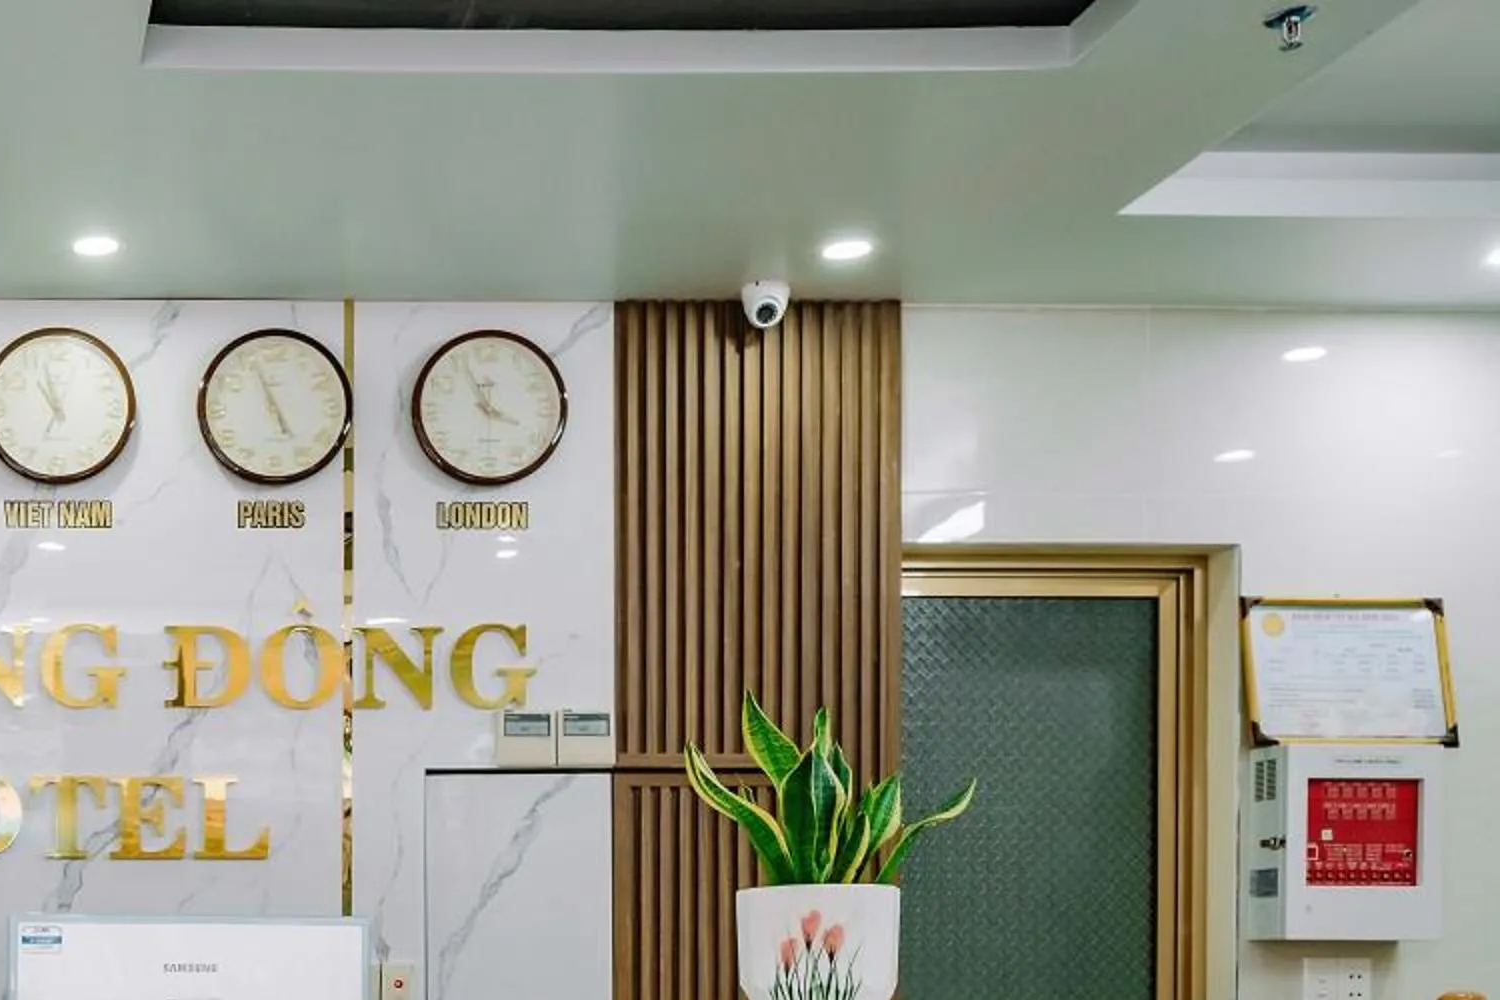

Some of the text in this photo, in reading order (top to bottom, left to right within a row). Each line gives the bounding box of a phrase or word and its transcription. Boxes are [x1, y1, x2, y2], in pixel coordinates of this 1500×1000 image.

[4, 500, 112, 528] VIET NAM
[237, 501, 305, 528] PARIS
[436, 502, 528, 529] LONDON
[163, 597, 536, 711] ĐÔNG
[163, 963, 218, 973] SAMSUNG
